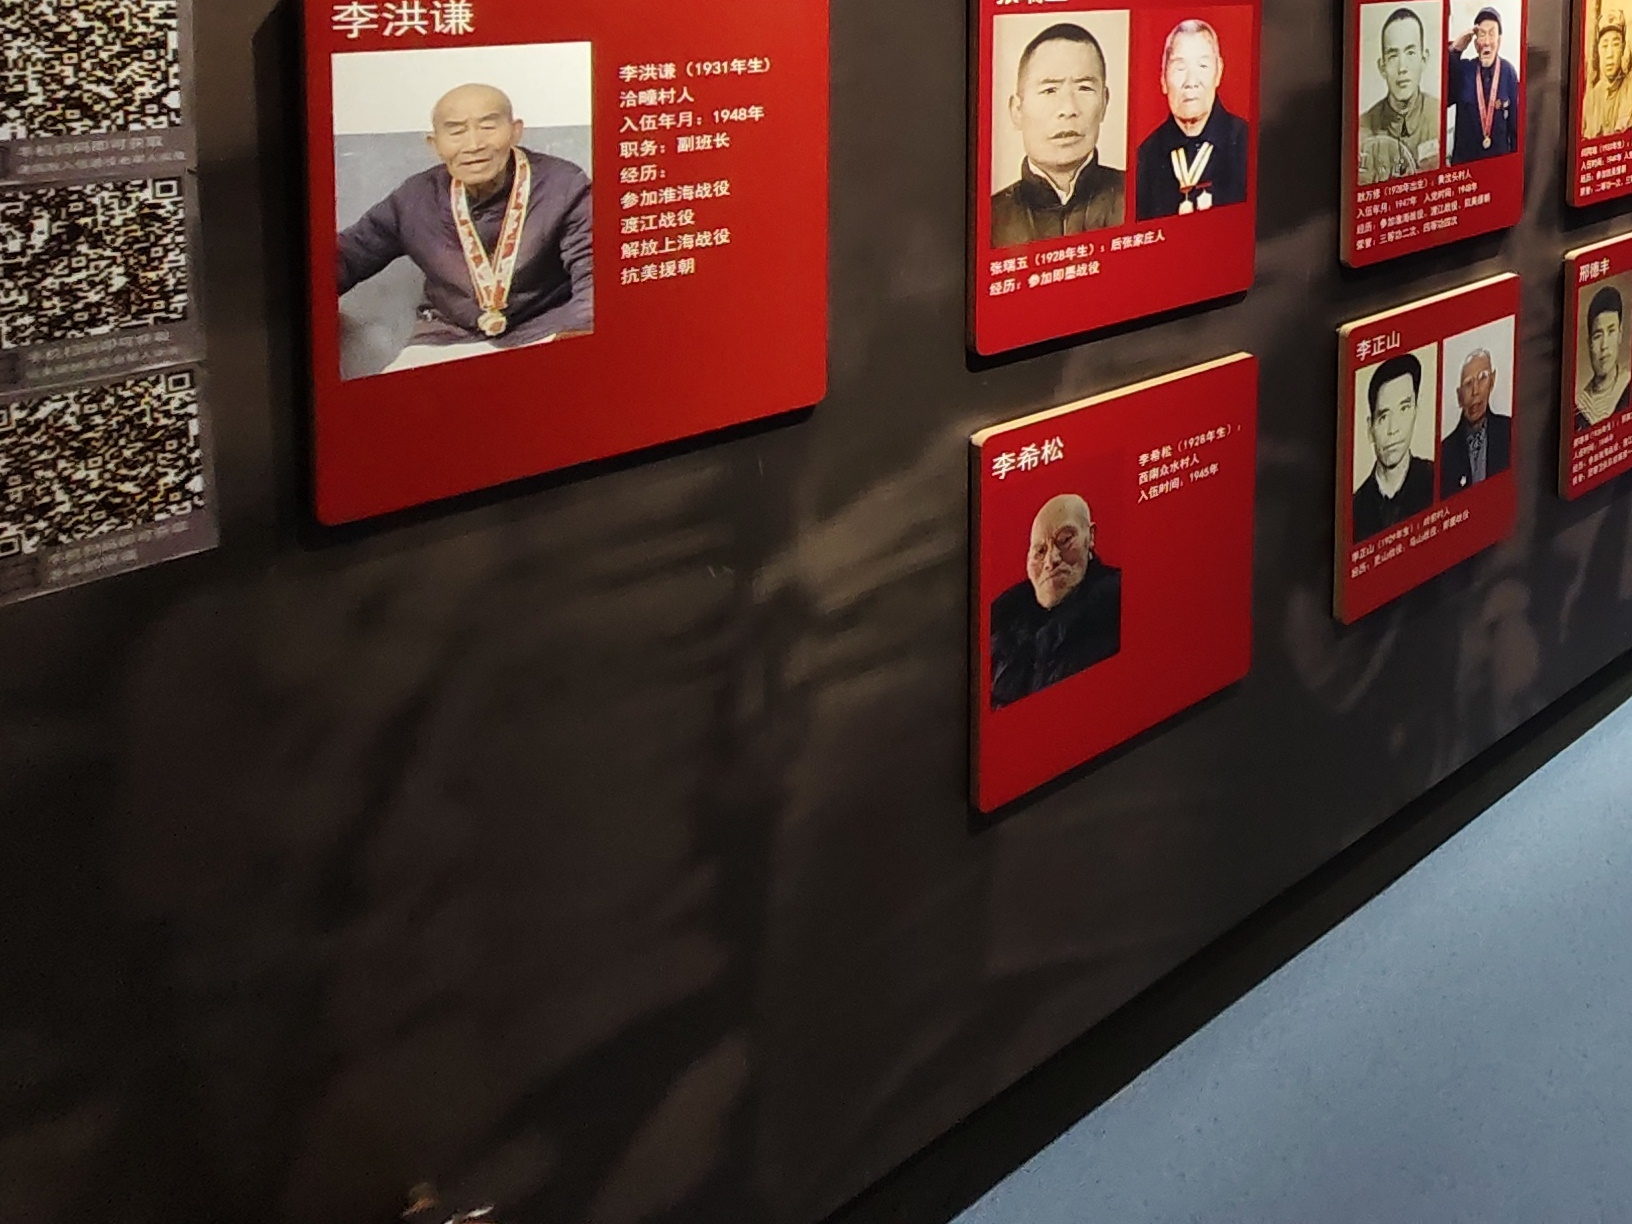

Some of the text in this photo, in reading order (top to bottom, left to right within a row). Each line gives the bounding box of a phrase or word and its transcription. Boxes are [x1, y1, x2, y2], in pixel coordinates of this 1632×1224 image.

[618, 57, 772, 83] 李洪谦（1931年生）
[619, 105, 766, 134] 入伍年月：1948年
[619, 132, 731, 159] 职务：副班长
[619, 164, 667, 185] 经历：
[620, 180, 731, 210] 参加淮海战役
[620, 208, 696, 235] 渡江战役
[620, 228, 731, 260] 解放上海战役
[620, 257, 696, 286] 抗美援朝
[988, 261, 1101, 297] 经历：参加即墨战役
[1355, 329, 1401, 362] 李正山
[991, 436, 1065, 480] 李希松
